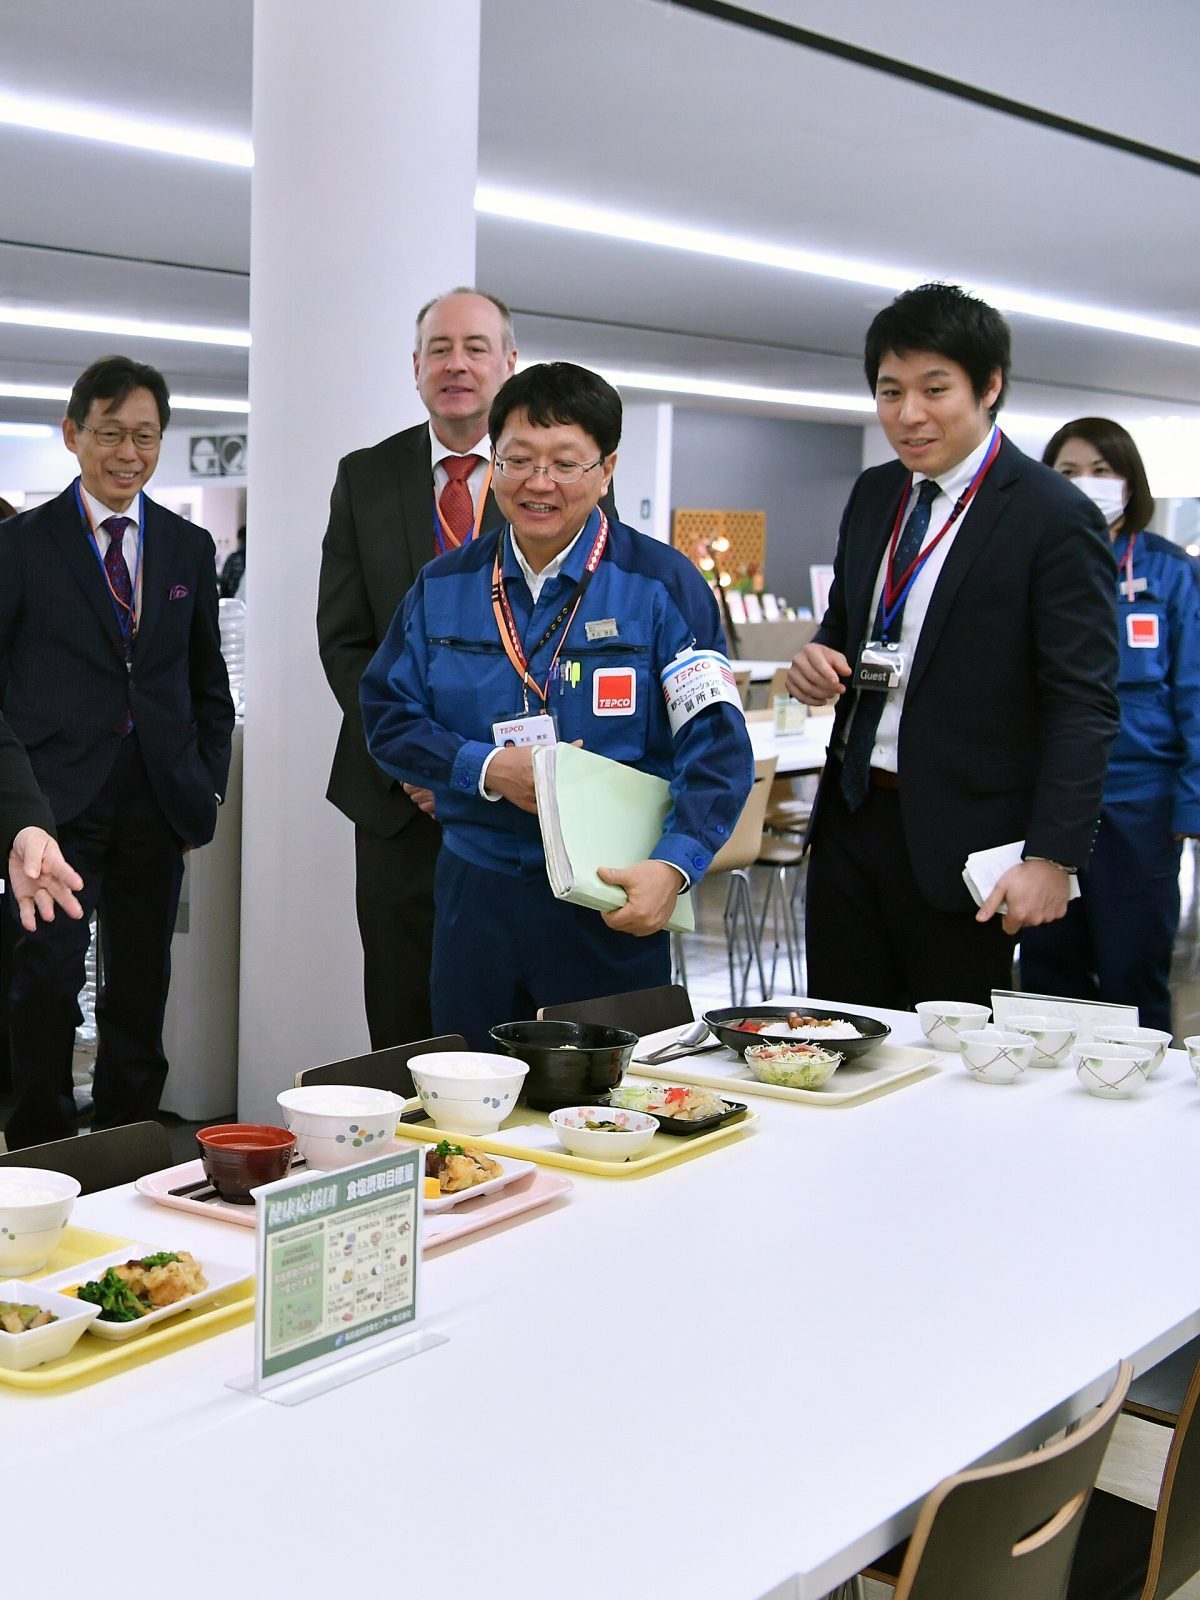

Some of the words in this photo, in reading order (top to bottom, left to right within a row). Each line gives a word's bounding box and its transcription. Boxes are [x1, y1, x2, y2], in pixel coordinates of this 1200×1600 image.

[674, 662, 710, 683] TEPCO
[860, 669, 887, 682] Guest
[599, 698, 631, 708] TEPCO
[500, 725, 524, 734] TEPCO
